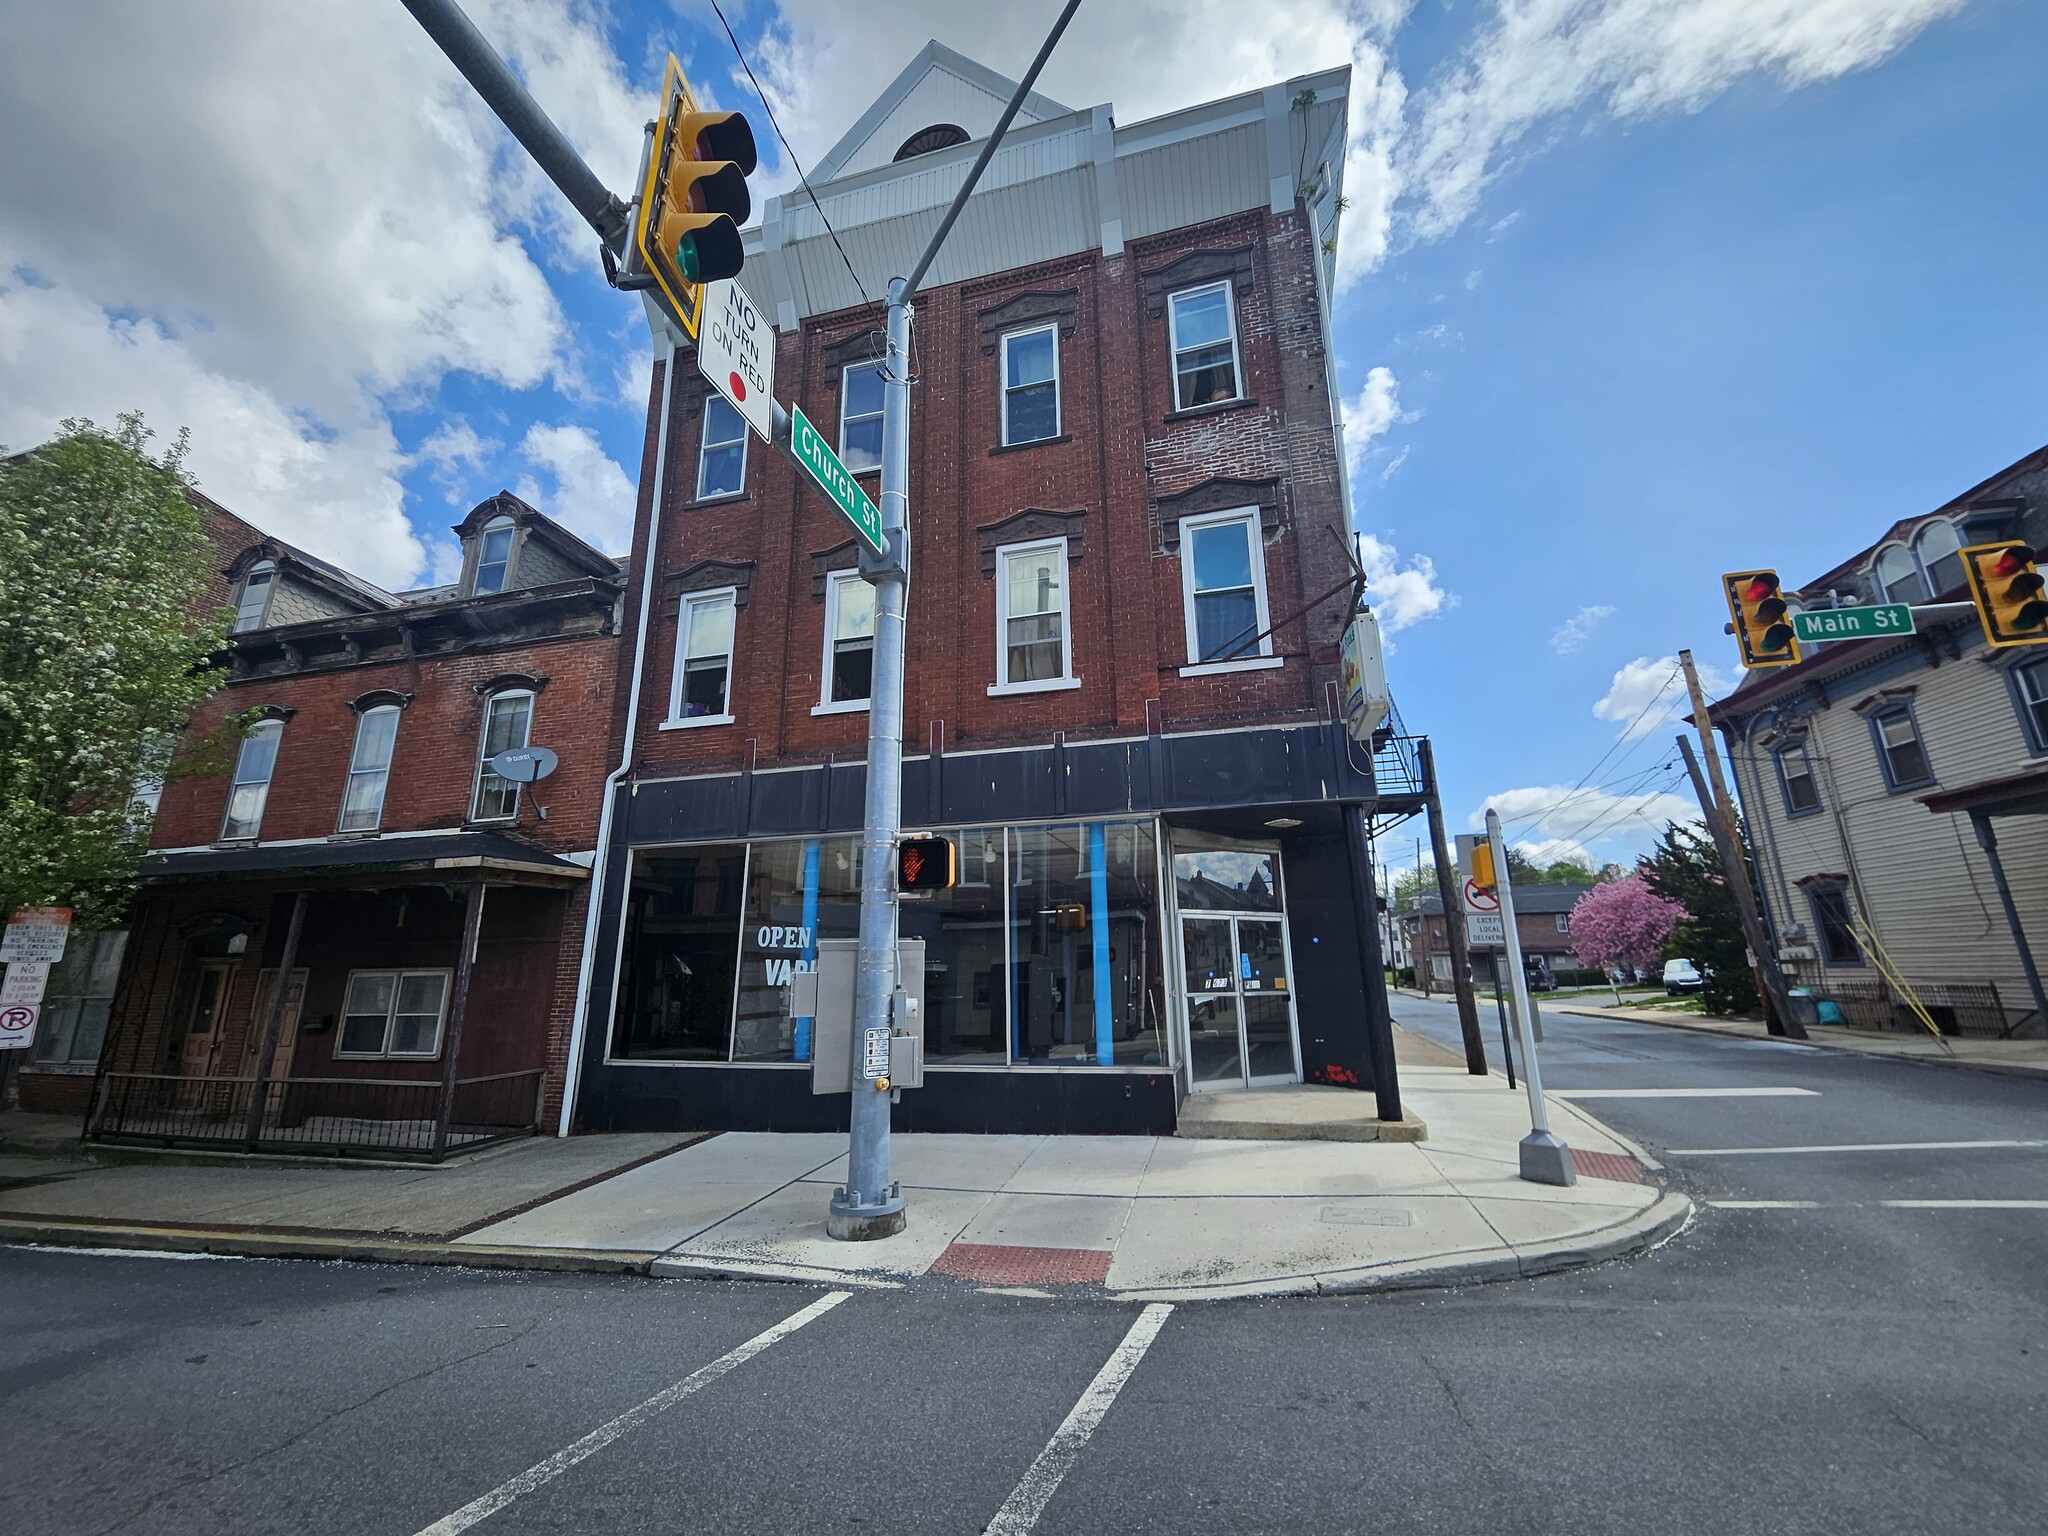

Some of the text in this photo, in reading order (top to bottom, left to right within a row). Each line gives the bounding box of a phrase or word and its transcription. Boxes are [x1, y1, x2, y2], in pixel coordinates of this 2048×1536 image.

[729, 283, 757, 333] NO
[724, 305, 760, 364] TURN
[712, 321, 765, 394] ON RED
[801, 426, 876, 534] Church St
[1806, 609, 1900, 634] Main St
[757, 926, 812, 949] OPEN
[9, 975, 43, 984] PARKING
[20, 965, 36, 974] NO
